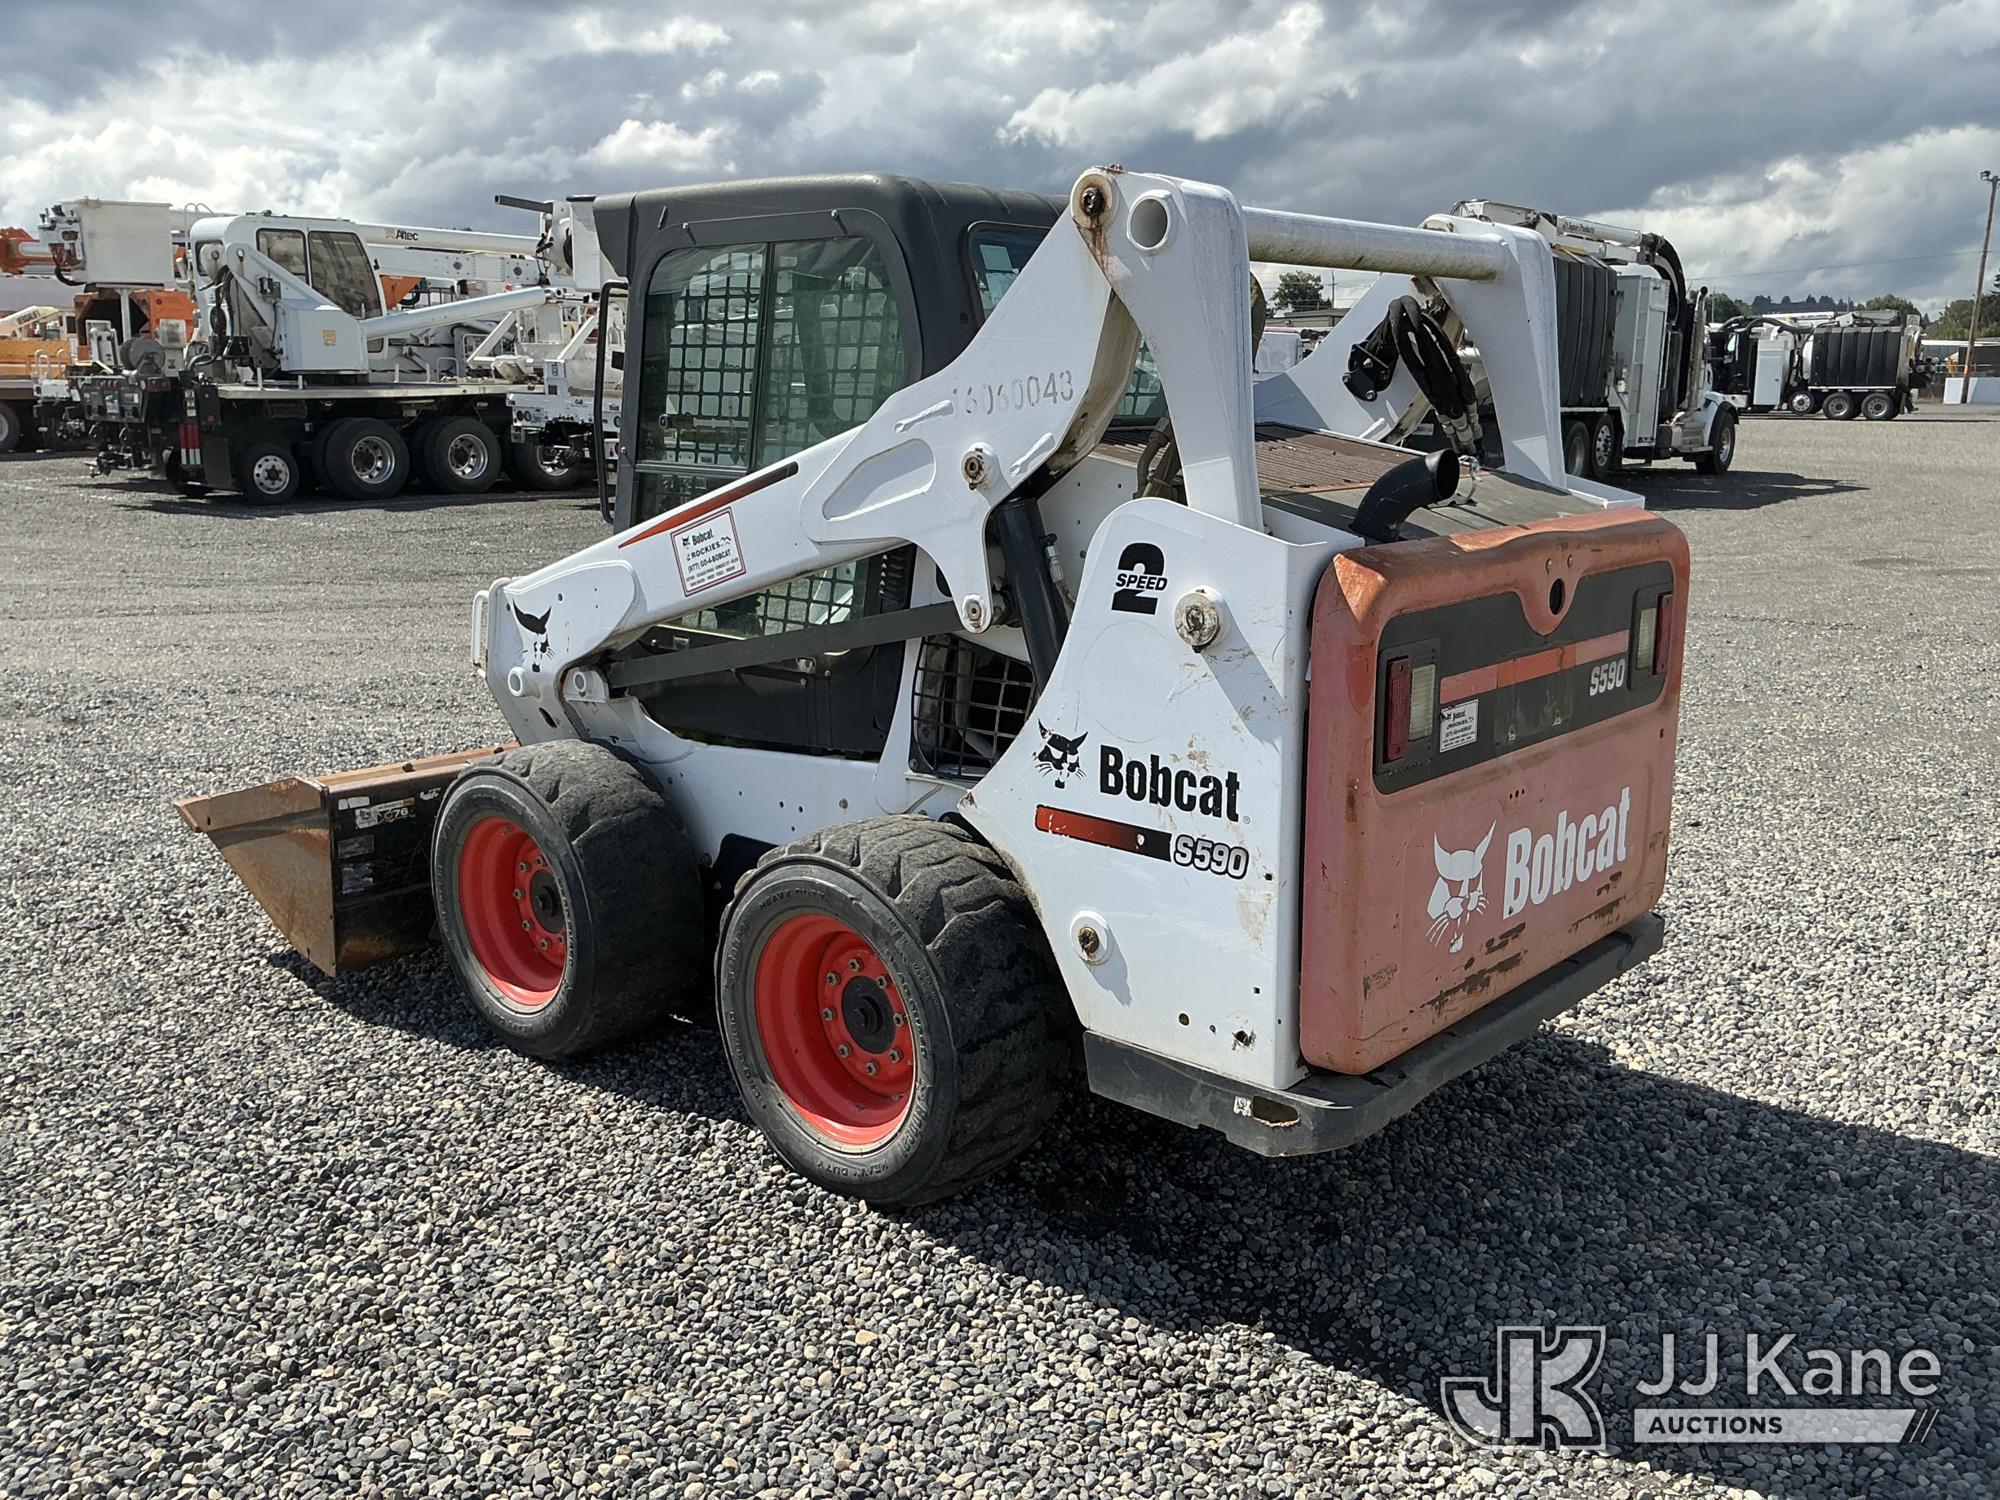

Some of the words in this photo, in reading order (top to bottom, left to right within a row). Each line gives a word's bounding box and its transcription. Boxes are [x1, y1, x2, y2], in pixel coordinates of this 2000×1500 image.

[691, 528, 714, 546] Bobcat
[691, 541, 721, 559] ROCKIES
[1111, 542, 1165, 615] 2
[1115, 573, 1168, 591] SPEED
[1589, 658, 1626, 697] S590
[1100, 745, 1240, 822] Bobcat
[1173, 834, 1249, 880] S590
[1503, 786, 1630, 921] Bobcat
